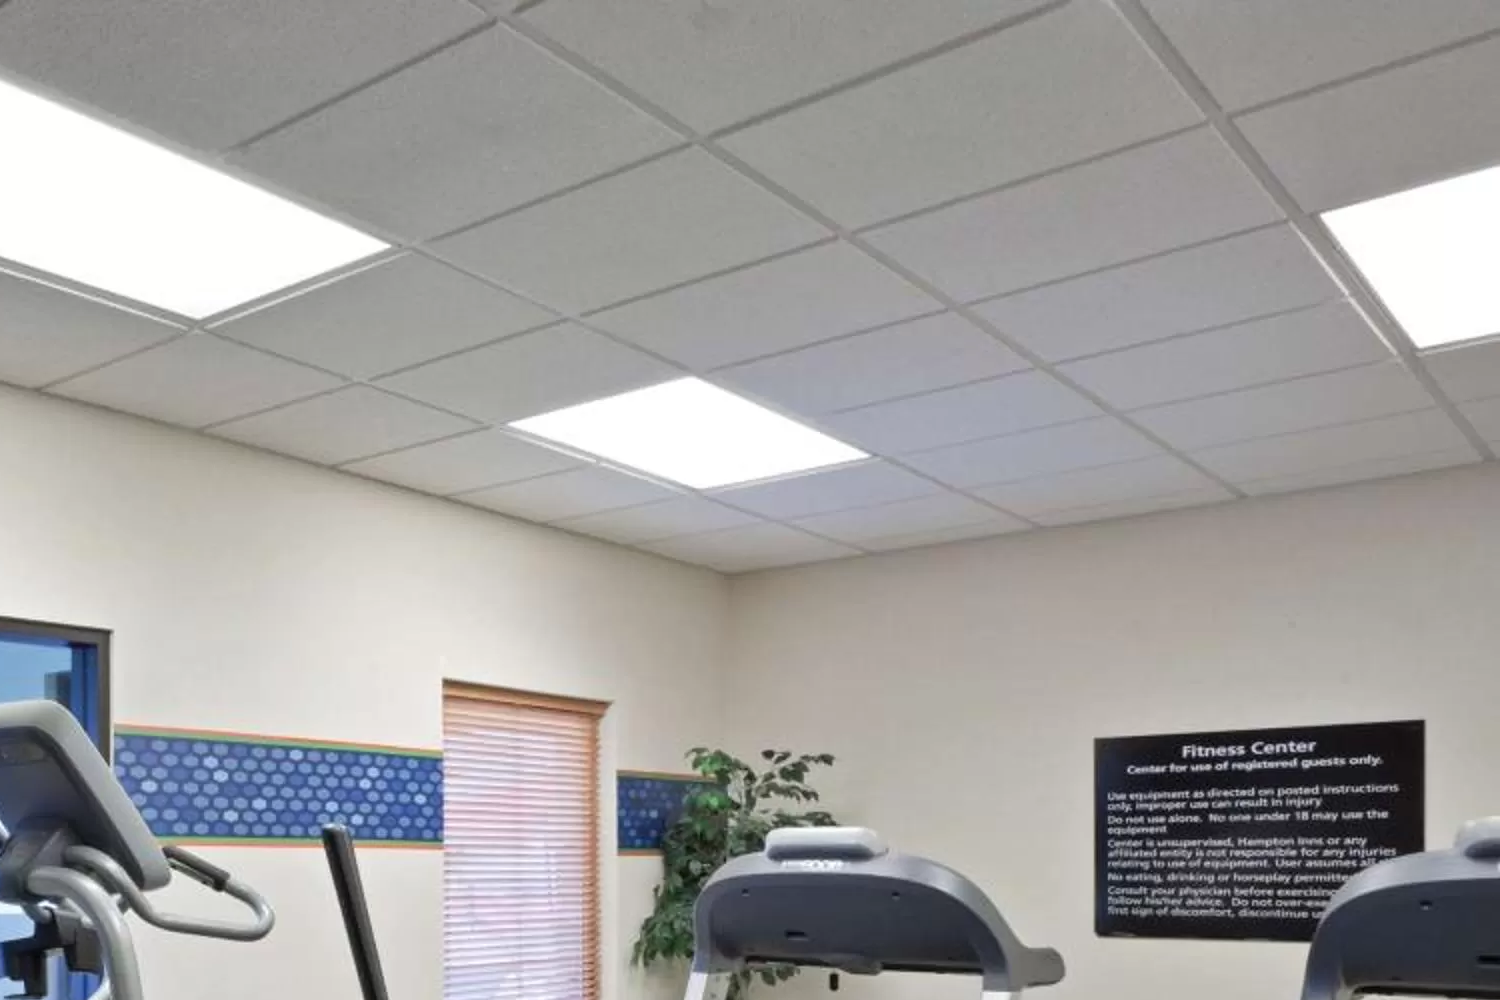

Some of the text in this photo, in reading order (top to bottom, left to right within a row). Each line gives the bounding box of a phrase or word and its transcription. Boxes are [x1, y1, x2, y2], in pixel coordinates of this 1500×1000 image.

[1182, 740, 1317, 758] Fitness Center
[1127, 764, 1166, 774] Center
[1169, 762, 1187, 773] for
[1190, 763, 1212, 772] use
[1215, 761, 1229, 771] of
[1231, 758, 1298, 772] registered
[1301, 756, 1346, 770] guests
[1107, 783, 1399, 802] Use equipment as directed on posted instructions
[1135, 801, 1186, 811] improper
[1189, 801, 1209, 809] use
[1211, 800, 1232, 809] can
[1234, 797, 1268, 807] result
[1271, 797, 1283, 806] in
[1285, 797, 1323, 809] injury
[1107, 815, 1123, 824] Do
[1125, 814, 1145, 824] not
[1147, 815, 1166, 824] use
[1208, 813, 1226, 822] No
[1228, 813, 1252, 821] one
[1254, 812, 1291, 821] under
[1295, 811, 1309, 820] 18
[1311, 812, 1339, 822] may
[1341, 811, 1364, 819] use
[1366, 809, 1389, 819] the
[1107, 826, 1167, 836] equipment
[1107, 839, 1143, 848] Center
[1146, 838, 1154, 848] is
[1327, 837, 1340, 845] or
[1343, 837, 1367, 848] any
[1107, 849, 1157, 858] affiliated
[1196, 848, 1204, 857] is
[1206, 848, 1227, 857] not
[1229, 847, 1297, 858] responsible
[1301, 847, 1317, 857] for
[1322, 848, 1346, 859] any
[1349, 846, 1397, 858] injuries
[1107, 859, 1150, 870] relating
[1153, 859, 1165, 868] to
[1167, 860, 1186, 868] use
[1187, 858, 1201, 868] of
[1275, 858, 1301, 868] User
[1305, 859, 1358, 868] assumes
[1107, 872, 1123, 881] No
[1166, 872, 1215, 883] drinking
[1233, 872, 1291, 883] horseplay
[1294, 872, 1350, 883] permitte
[1107, 886, 1149, 896] Consult
[1152, 887, 1176, 897] your
[1178, 886, 1231, 897] physician
[1233, 885, 1274, 896] before
[1231, 897, 1249, 907] Do
[1251, 897, 1272, 907] not
